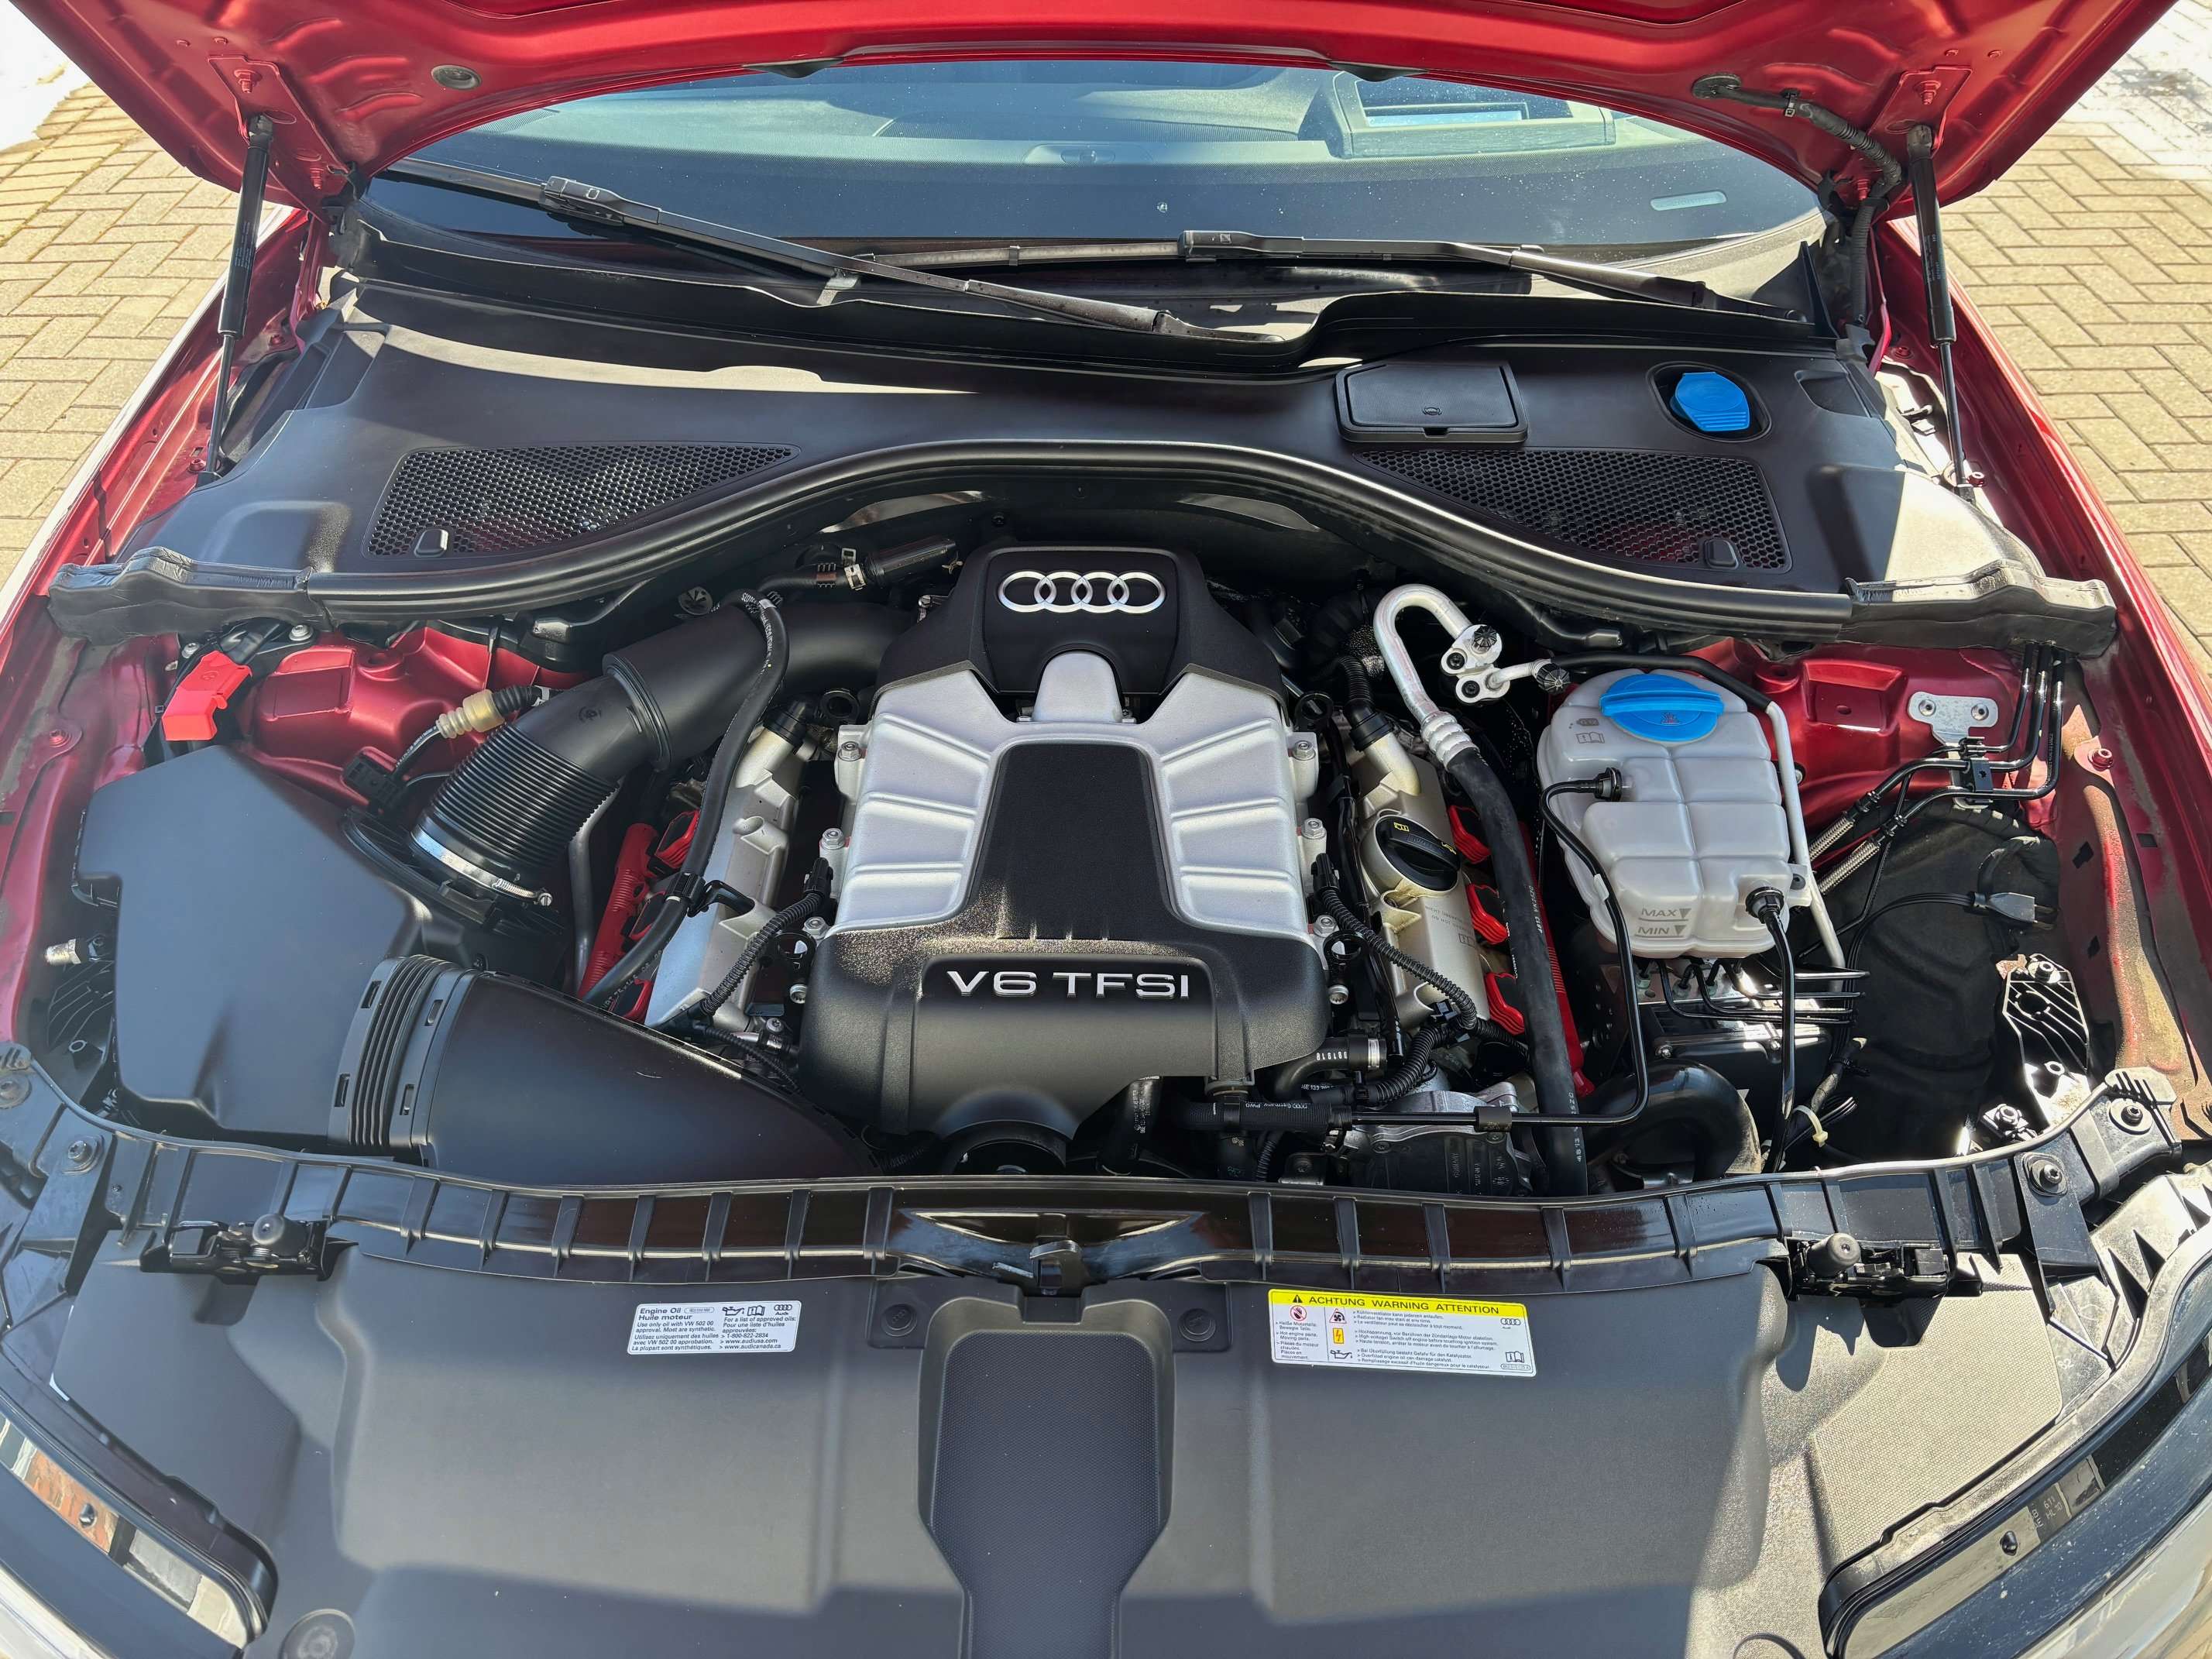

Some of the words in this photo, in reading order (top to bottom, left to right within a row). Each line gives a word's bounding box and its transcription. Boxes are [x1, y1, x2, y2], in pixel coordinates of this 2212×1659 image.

[1642, 908, 1678, 917] MAX
[1637, 926, 1670, 935] MIN
[946, 970, 1037, 997] V6
[1053, 971, 1189, 1000] TFSI
[1309, 1297, 1365, 1306] ACHTUNG
[1372, 1300, 1429, 1310] WARNING
[1436, 1304, 1499, 1314] ATTENTION
